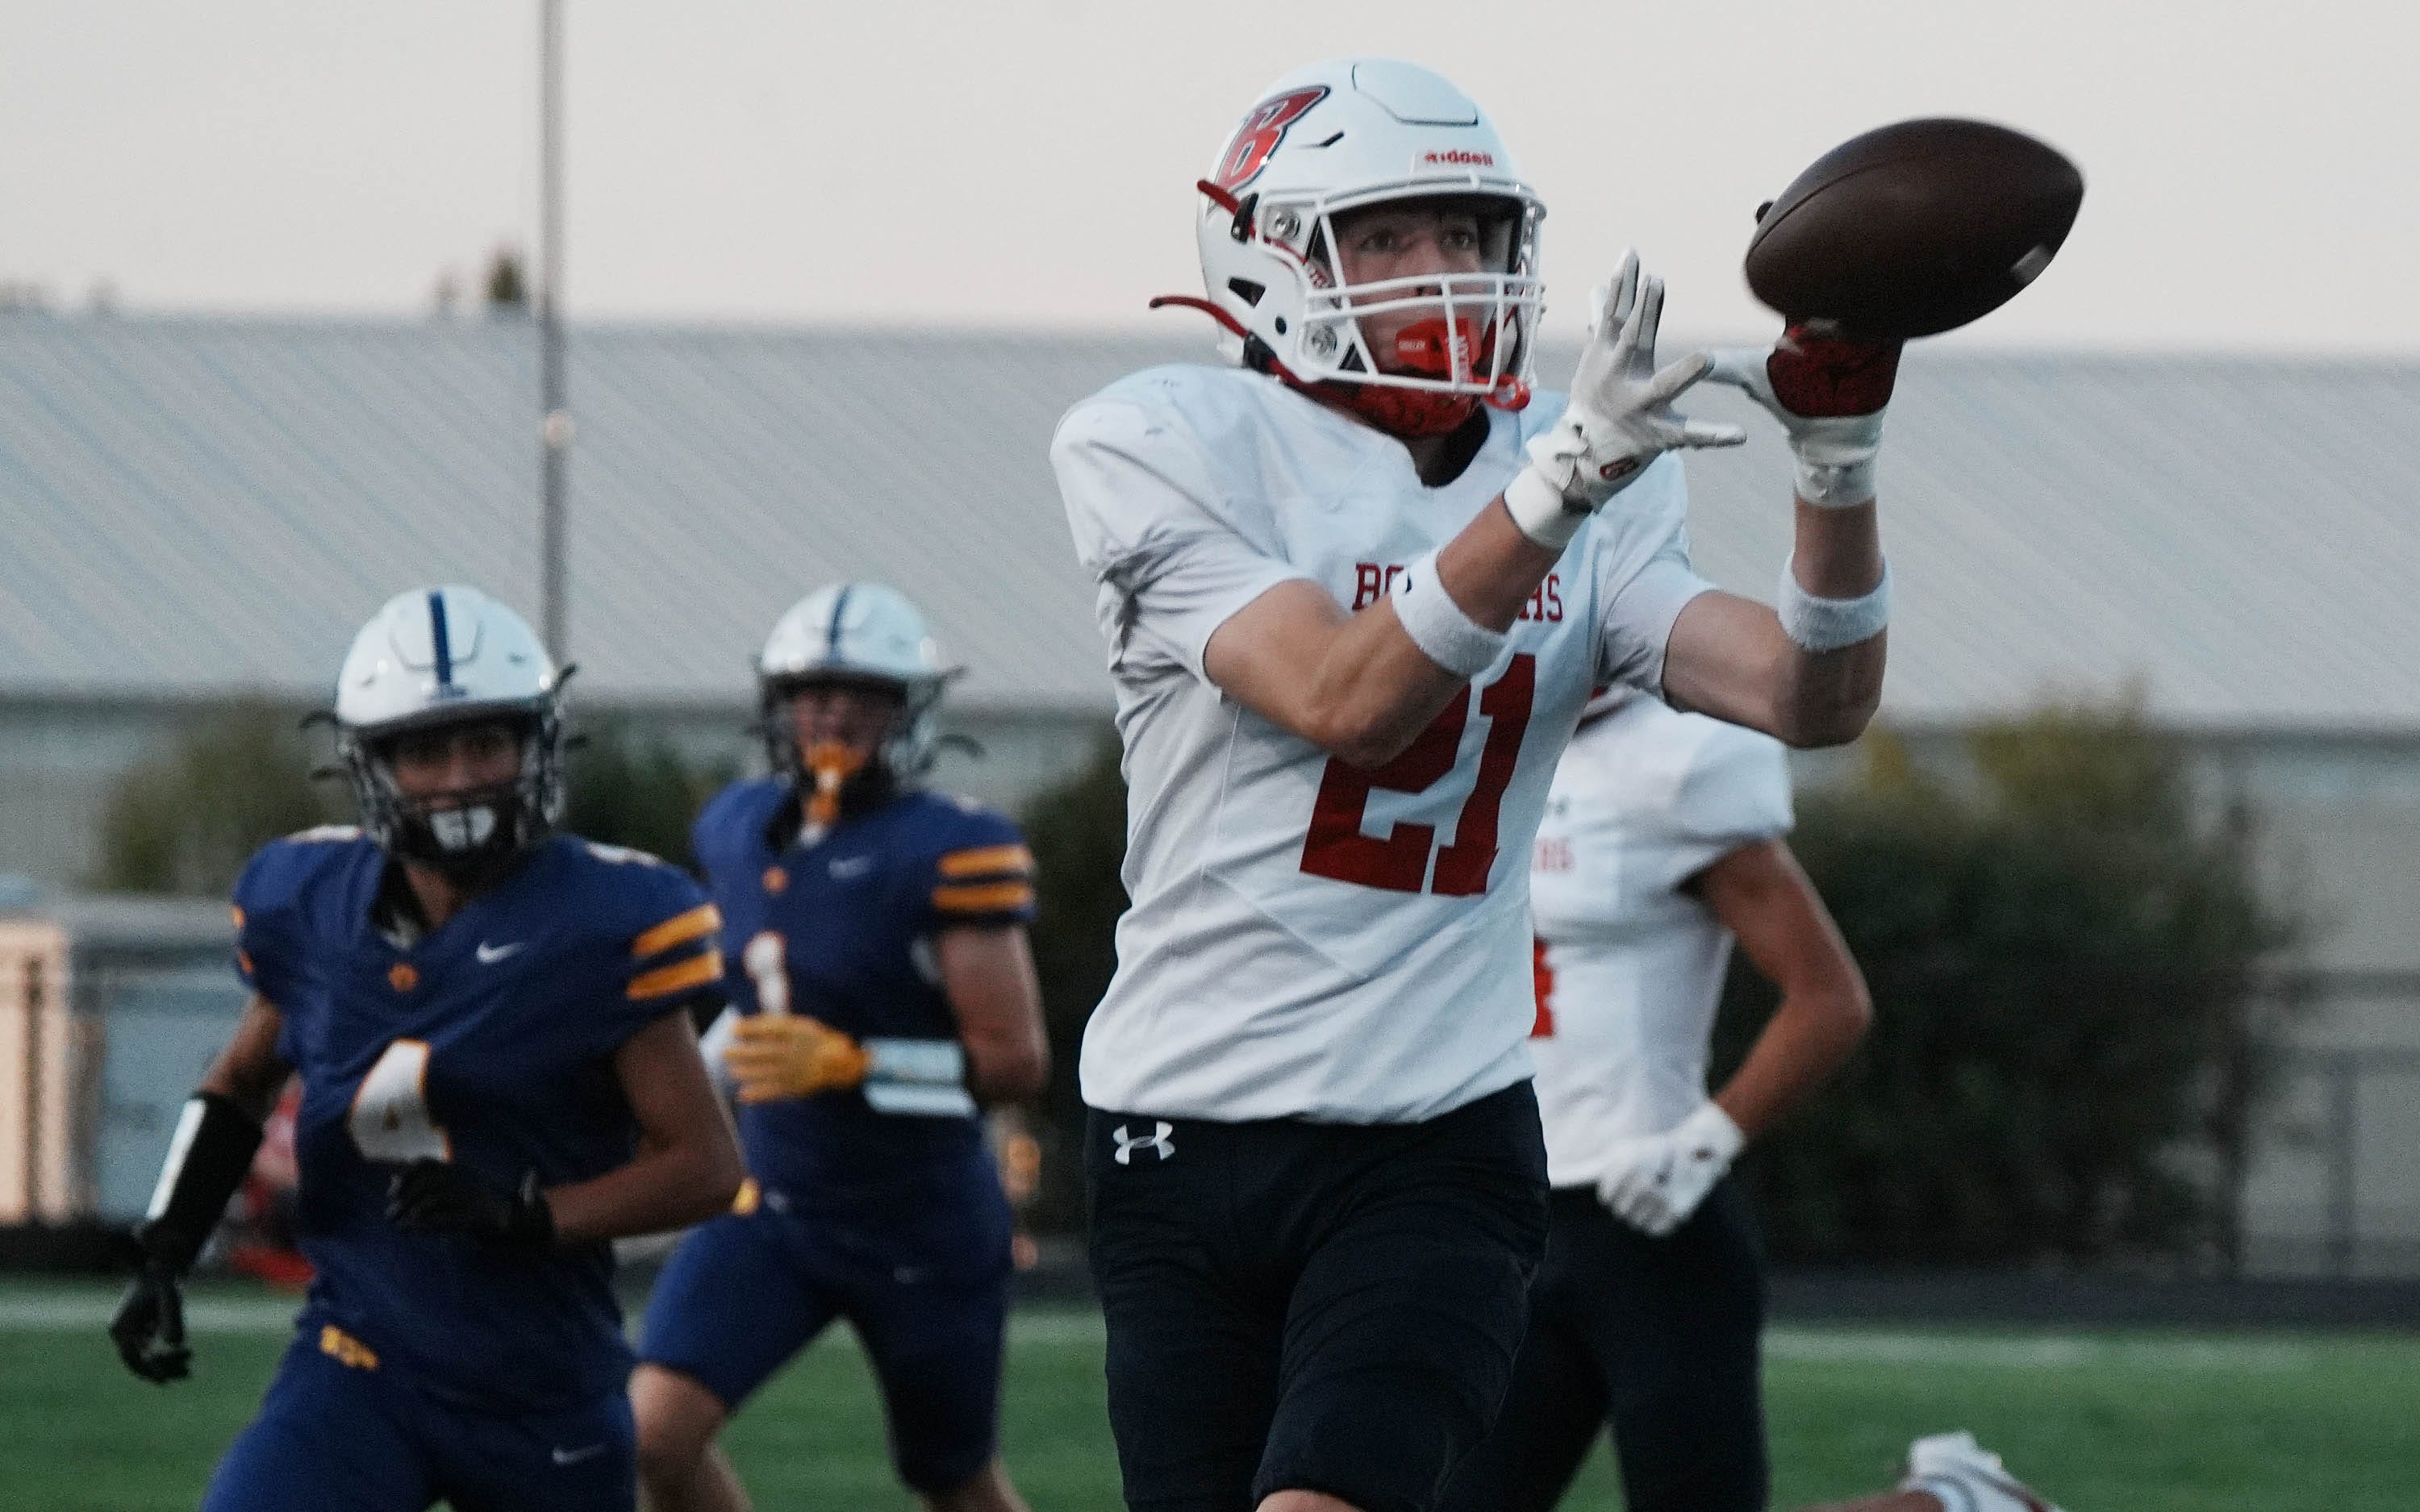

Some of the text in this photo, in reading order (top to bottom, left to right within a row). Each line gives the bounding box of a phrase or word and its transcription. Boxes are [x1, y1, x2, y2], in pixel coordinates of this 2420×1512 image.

[1209, 85, 1331, 208] B
[1299, 652, 1537, 898] 21
[348, 1039, 453, 1164] 4
